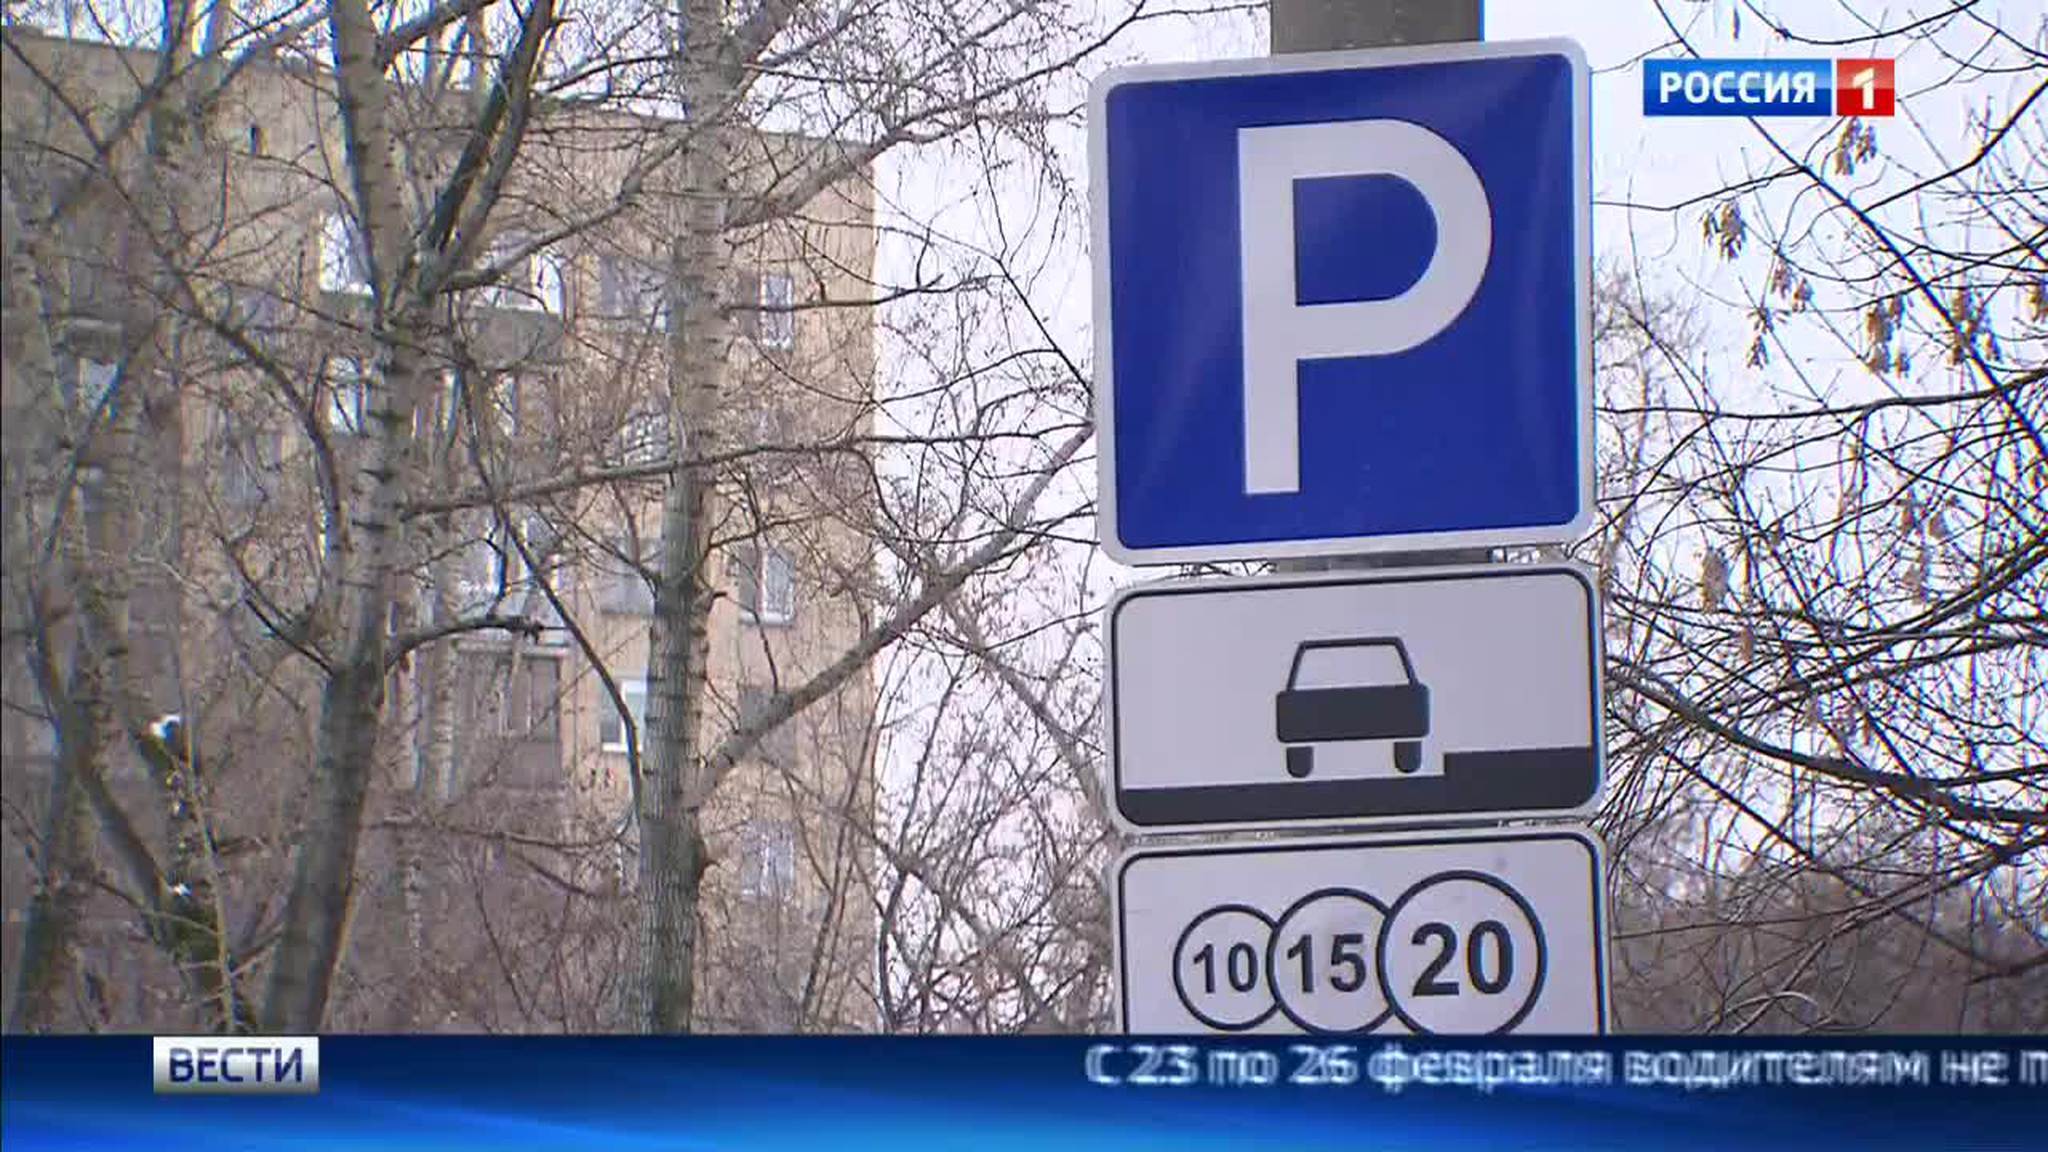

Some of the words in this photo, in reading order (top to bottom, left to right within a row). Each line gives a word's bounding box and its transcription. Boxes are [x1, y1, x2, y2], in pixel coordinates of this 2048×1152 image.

[1237, 117, 1493, 495] P
[1192, 942, 1259, 995] 10
[1287, 933, 1367, 993] 15
[1411, 920, 1515, 997] 20
